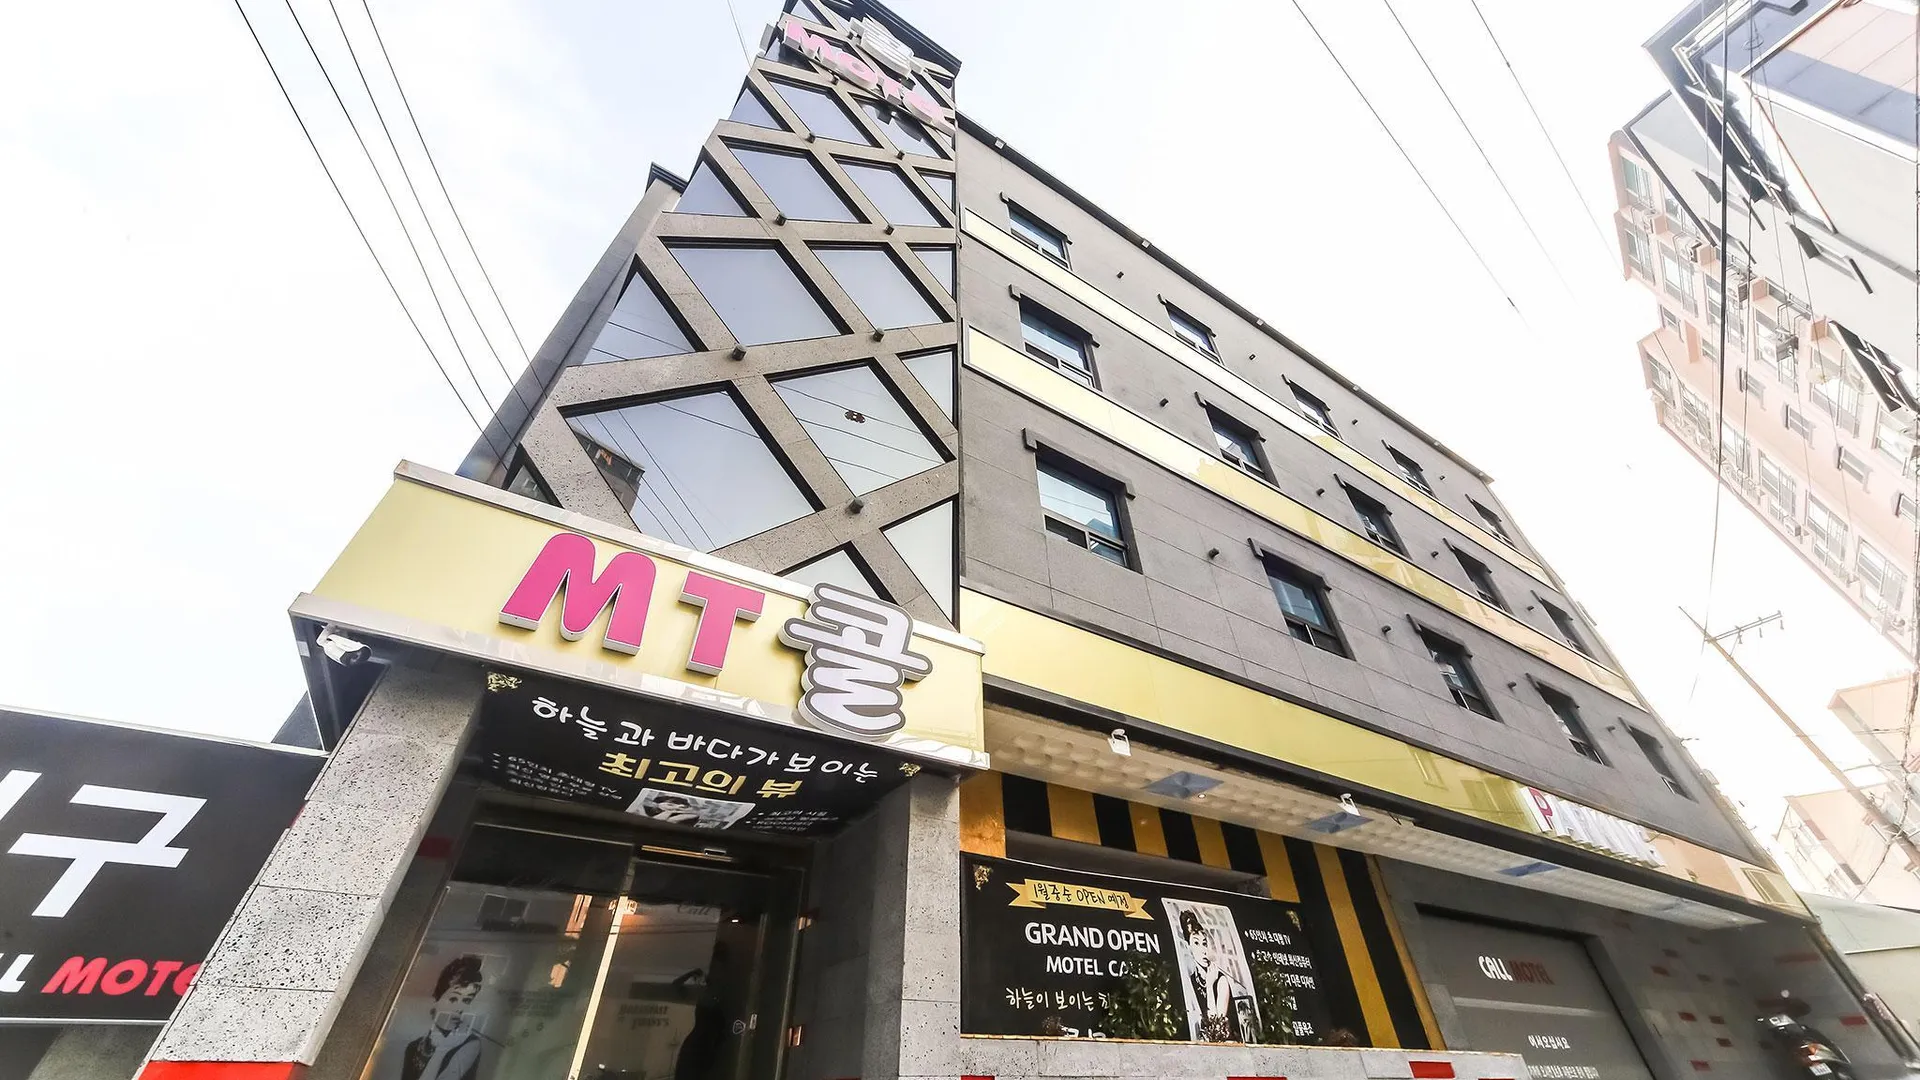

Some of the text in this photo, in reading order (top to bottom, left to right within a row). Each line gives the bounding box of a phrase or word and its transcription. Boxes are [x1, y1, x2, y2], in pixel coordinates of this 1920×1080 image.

[599, 751, 747, 795] 최고의
[757, 778, 803, 799] 뷰
[783, 752, 879, 784] 보이는
[1076, 889, 1106, 905] OPEN
[1107, 894, 1130, 909] 예정
[1025, 921, 1161, 954] GRAND OPEN
[1046, 955, 1104, 976] MOTEL
[1478, 955, 1514, 982] CALL
[1005, 986, 1050, 1010] 하늘이
[1055, 989, 1095, 1012] 보이는
